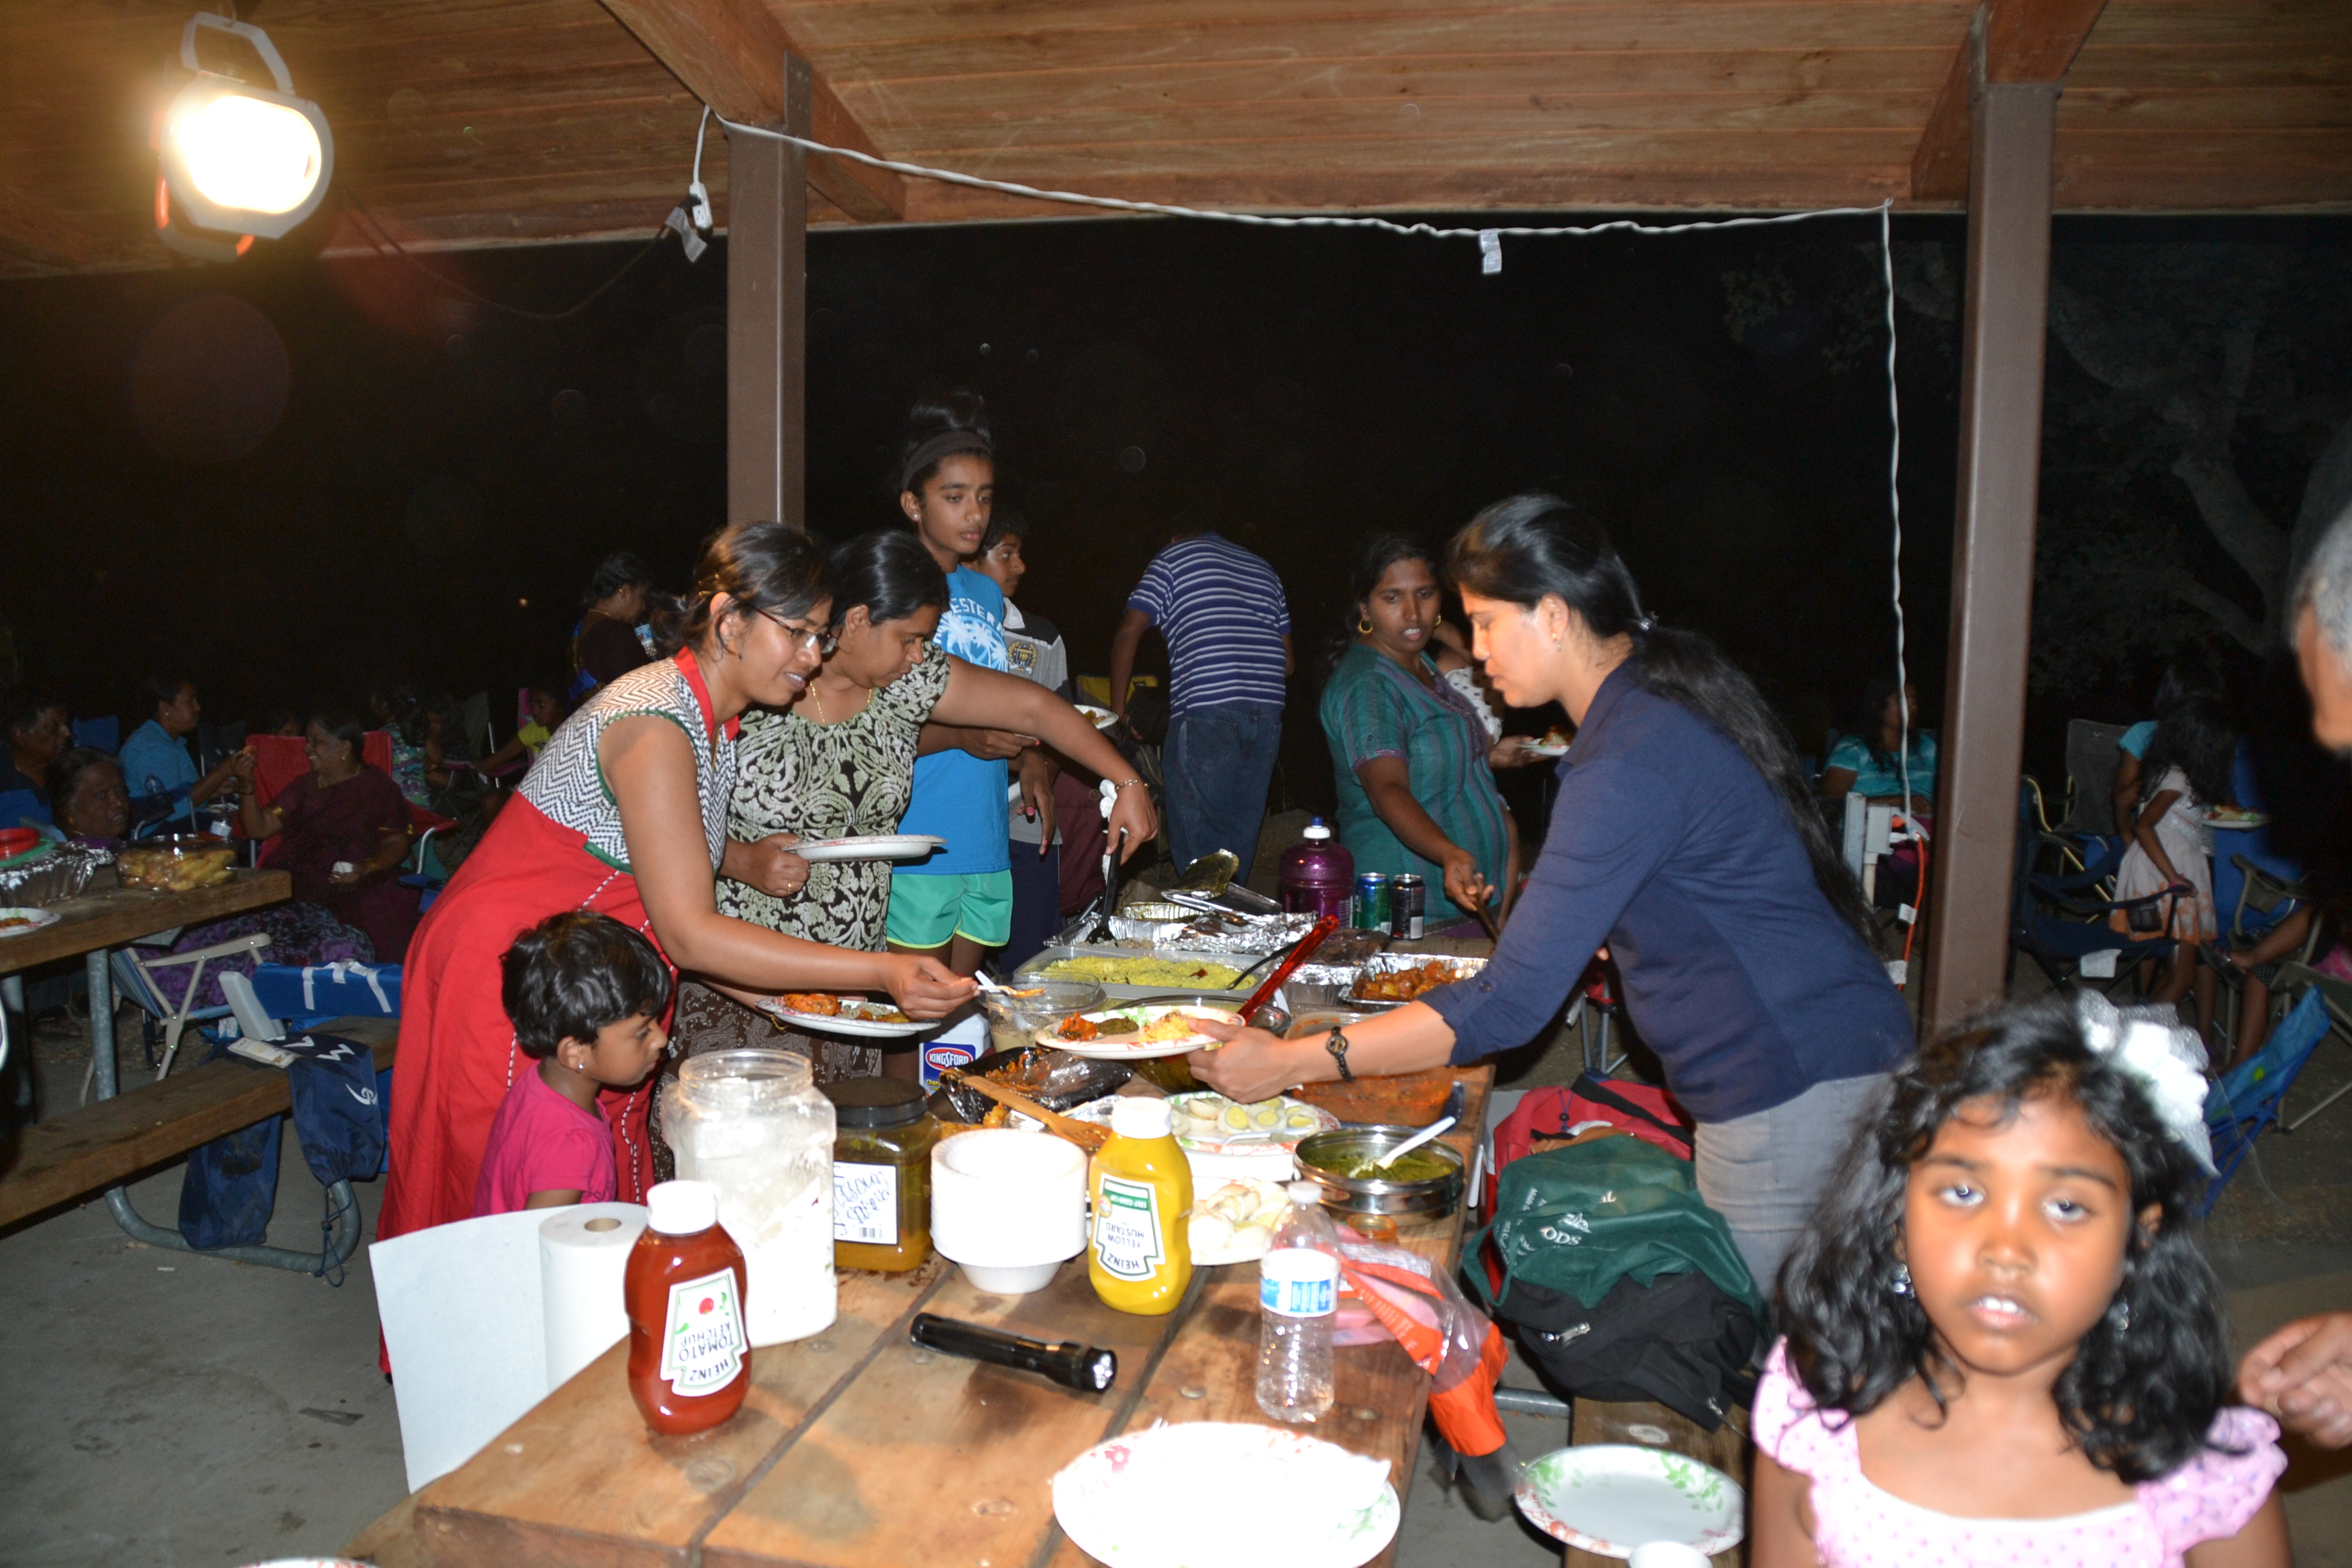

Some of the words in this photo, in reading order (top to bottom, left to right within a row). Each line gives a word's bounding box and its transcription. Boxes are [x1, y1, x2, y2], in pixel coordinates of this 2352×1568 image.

[929, 1051, 969, 1067] KINGSFORD
[1106, 1222, 1144, 1238] MUSTARD
[1107, 1233, 1141, 1248] YELLOW
[1107, 1253, 1140, 1270] HEINZ
[681, 1322, 730, 1348] KETCHUP
[679, 1333, 734, 1362] TOMATO
[689, 1358, 729, 1382] HEINZ
